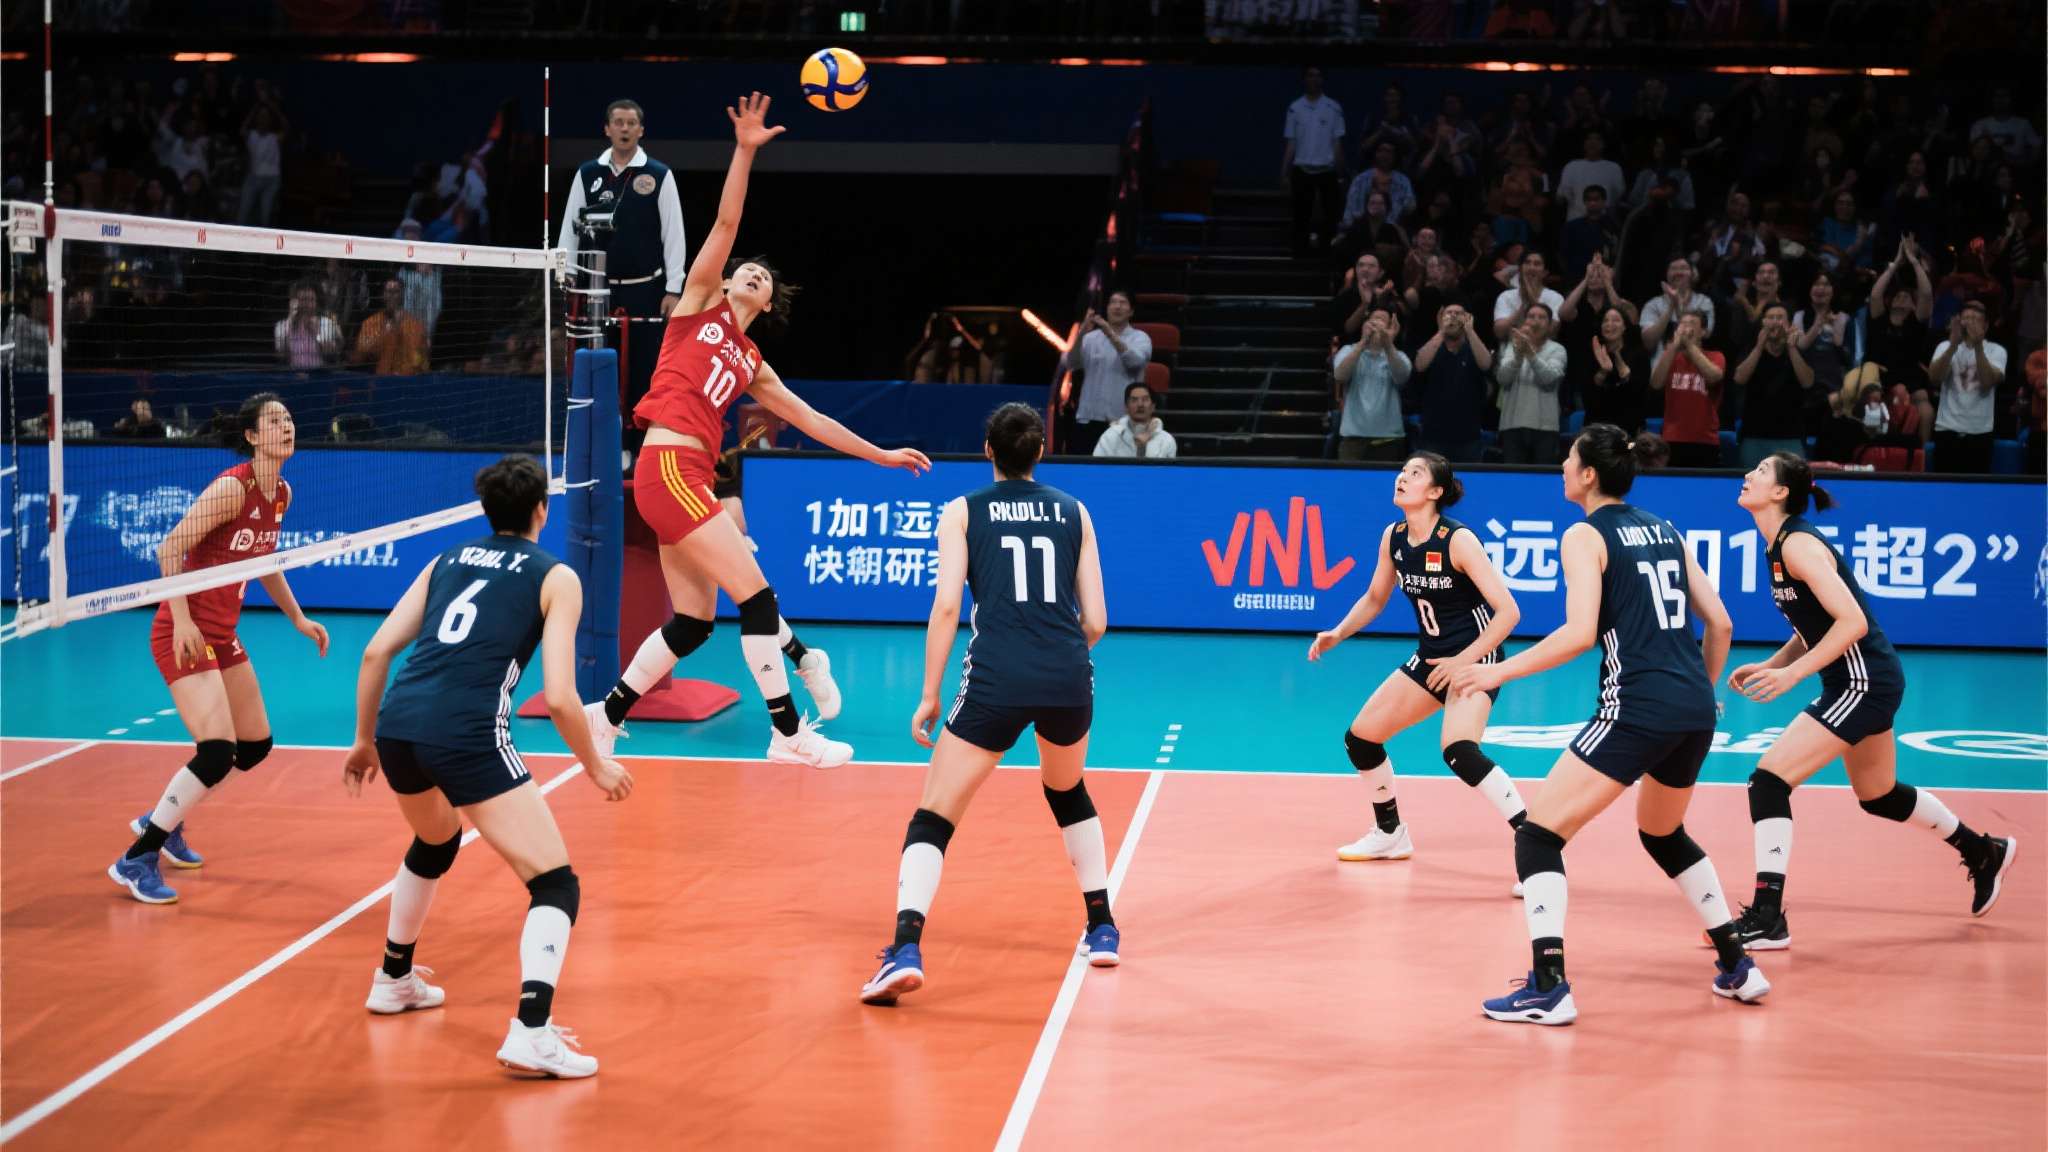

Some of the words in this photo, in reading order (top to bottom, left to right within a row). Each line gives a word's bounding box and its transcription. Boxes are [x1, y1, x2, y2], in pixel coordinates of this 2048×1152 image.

[704, 355, 736, 408] 10
[806, 497, 947, 539] 1加1远
[1201, 496, 1357, 590] VNL
[1001, 536, 1057, 603] 11
[1637, 559, 1686, 630] 15
[437, 579, 489, 644] 6
[1417, 598, 1440, 637] 0
